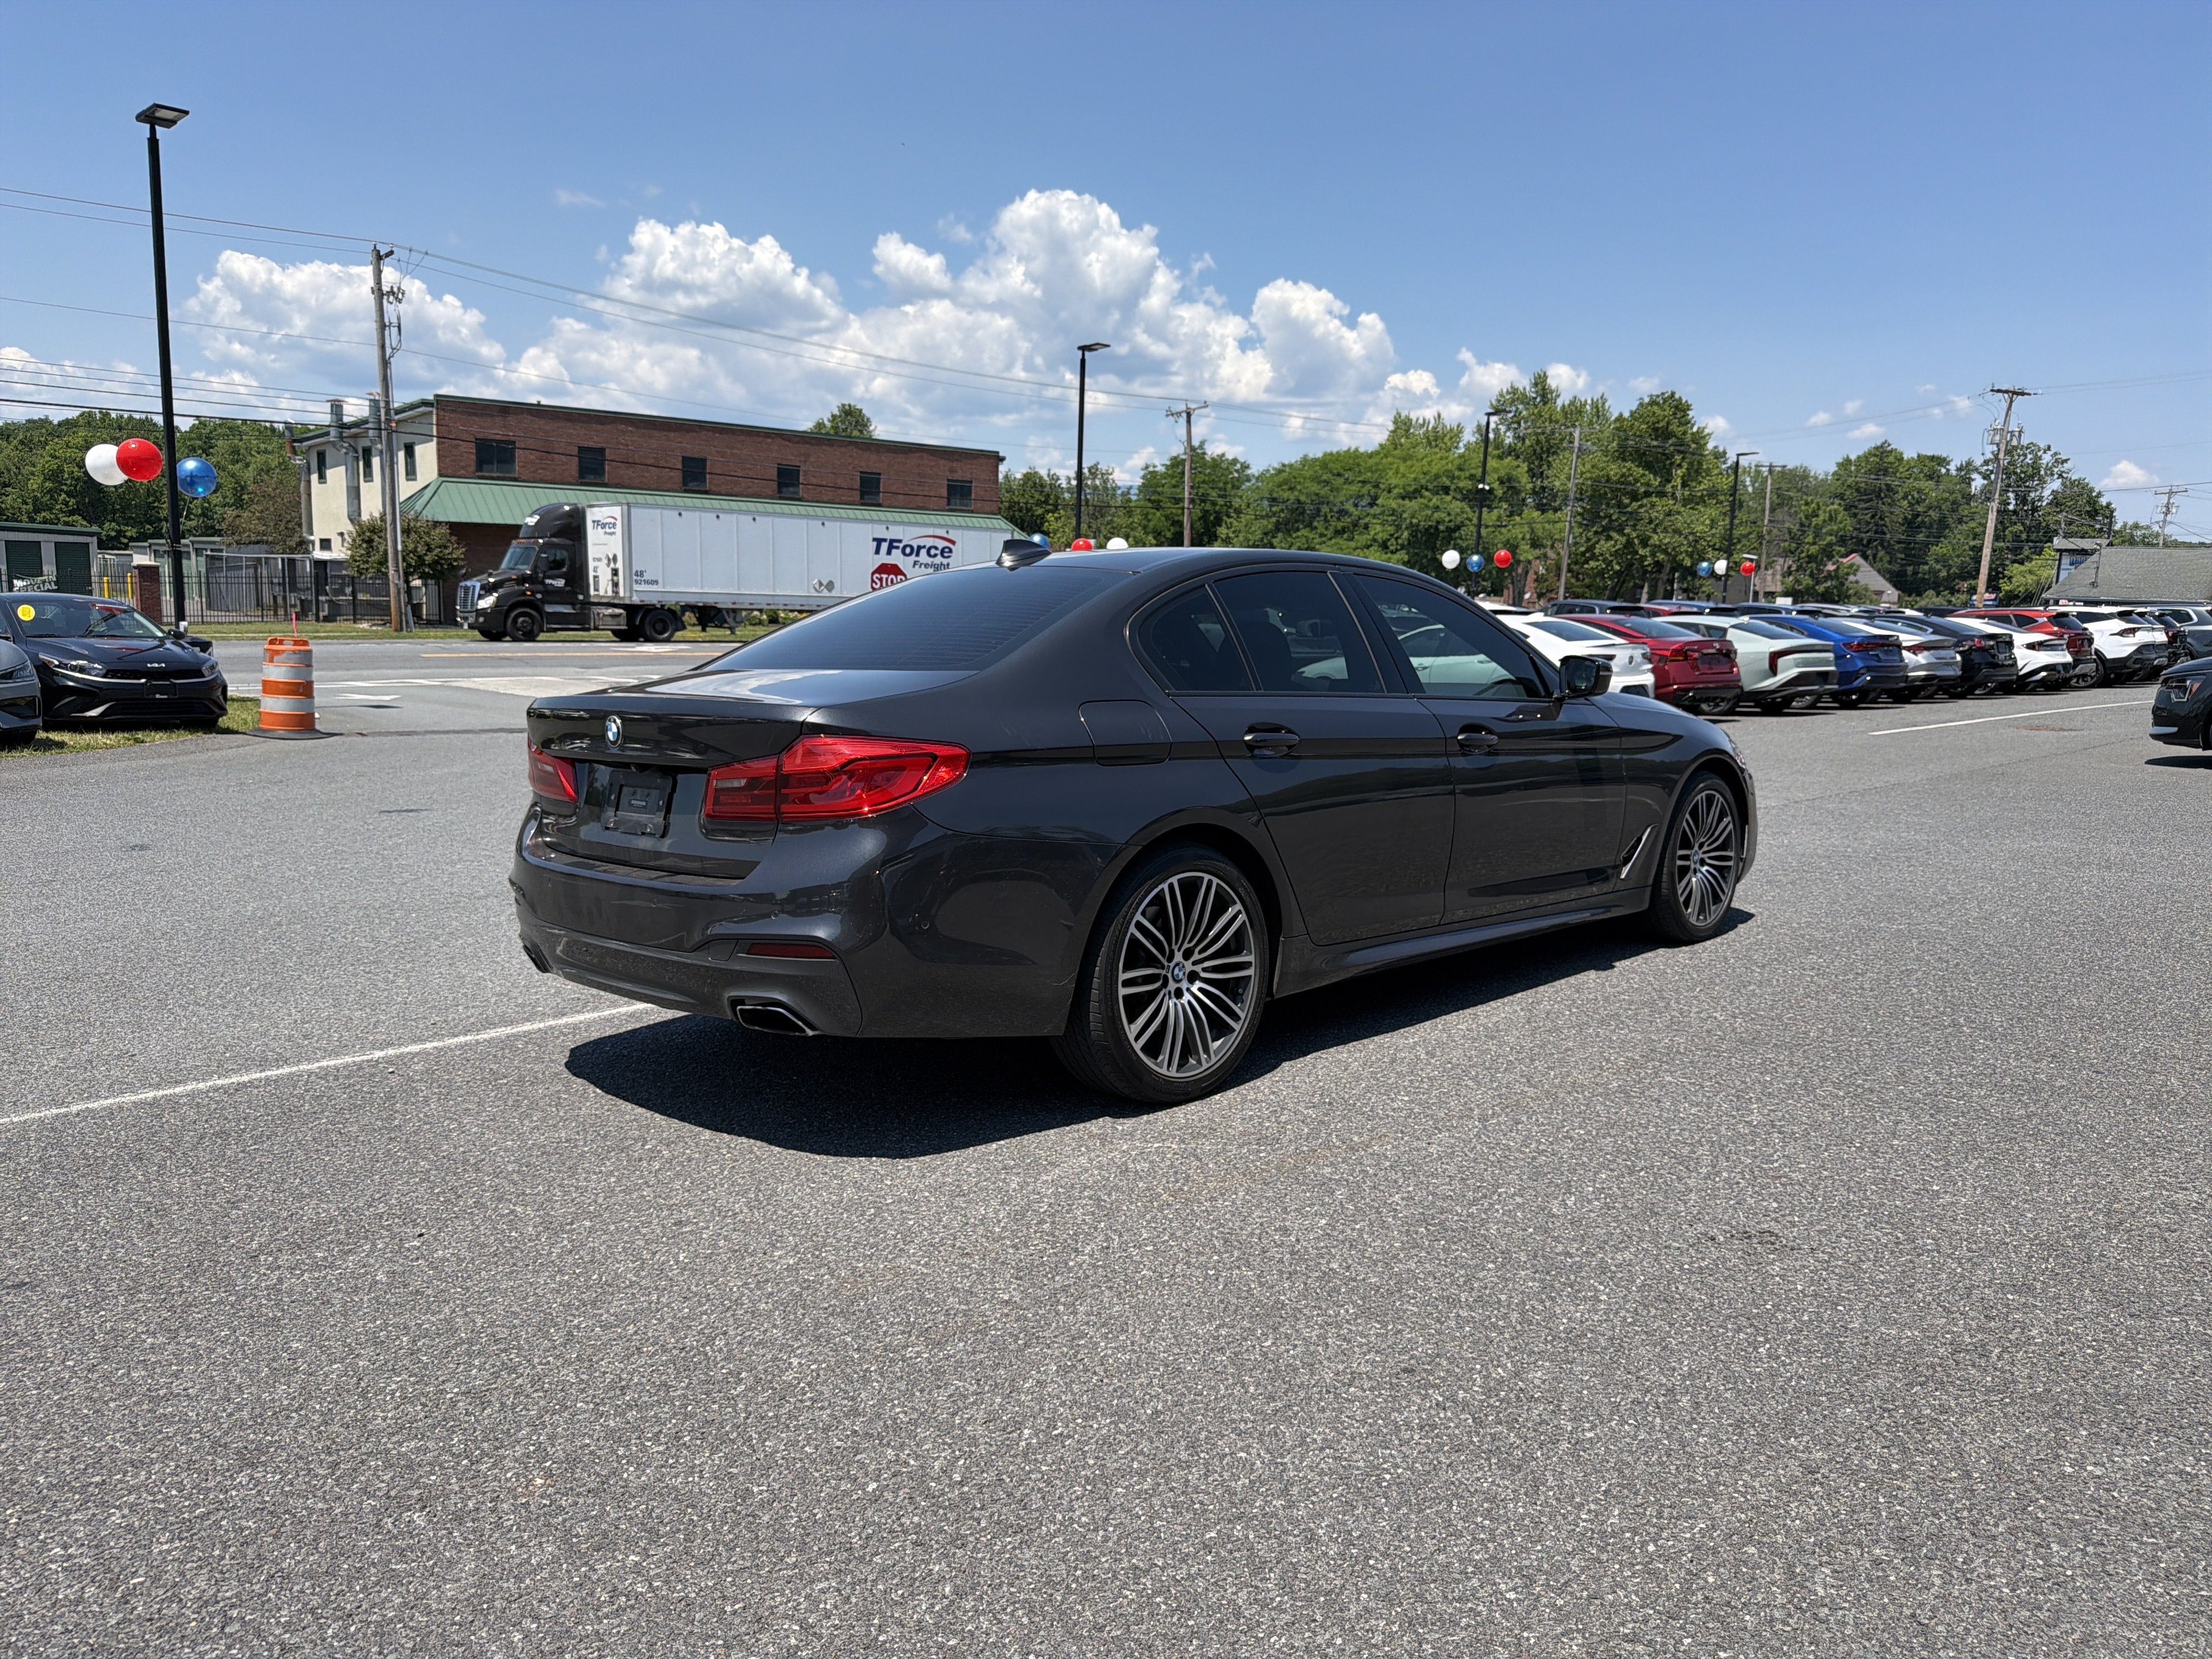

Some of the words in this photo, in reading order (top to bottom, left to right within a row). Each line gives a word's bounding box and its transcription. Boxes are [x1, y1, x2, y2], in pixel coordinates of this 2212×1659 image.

[592, 520, 617, 531] TForce
[872, 538, 953, 559] TForce
[912, 560, 951, 572] Freight
[634, 570, 647, 578] 48'
